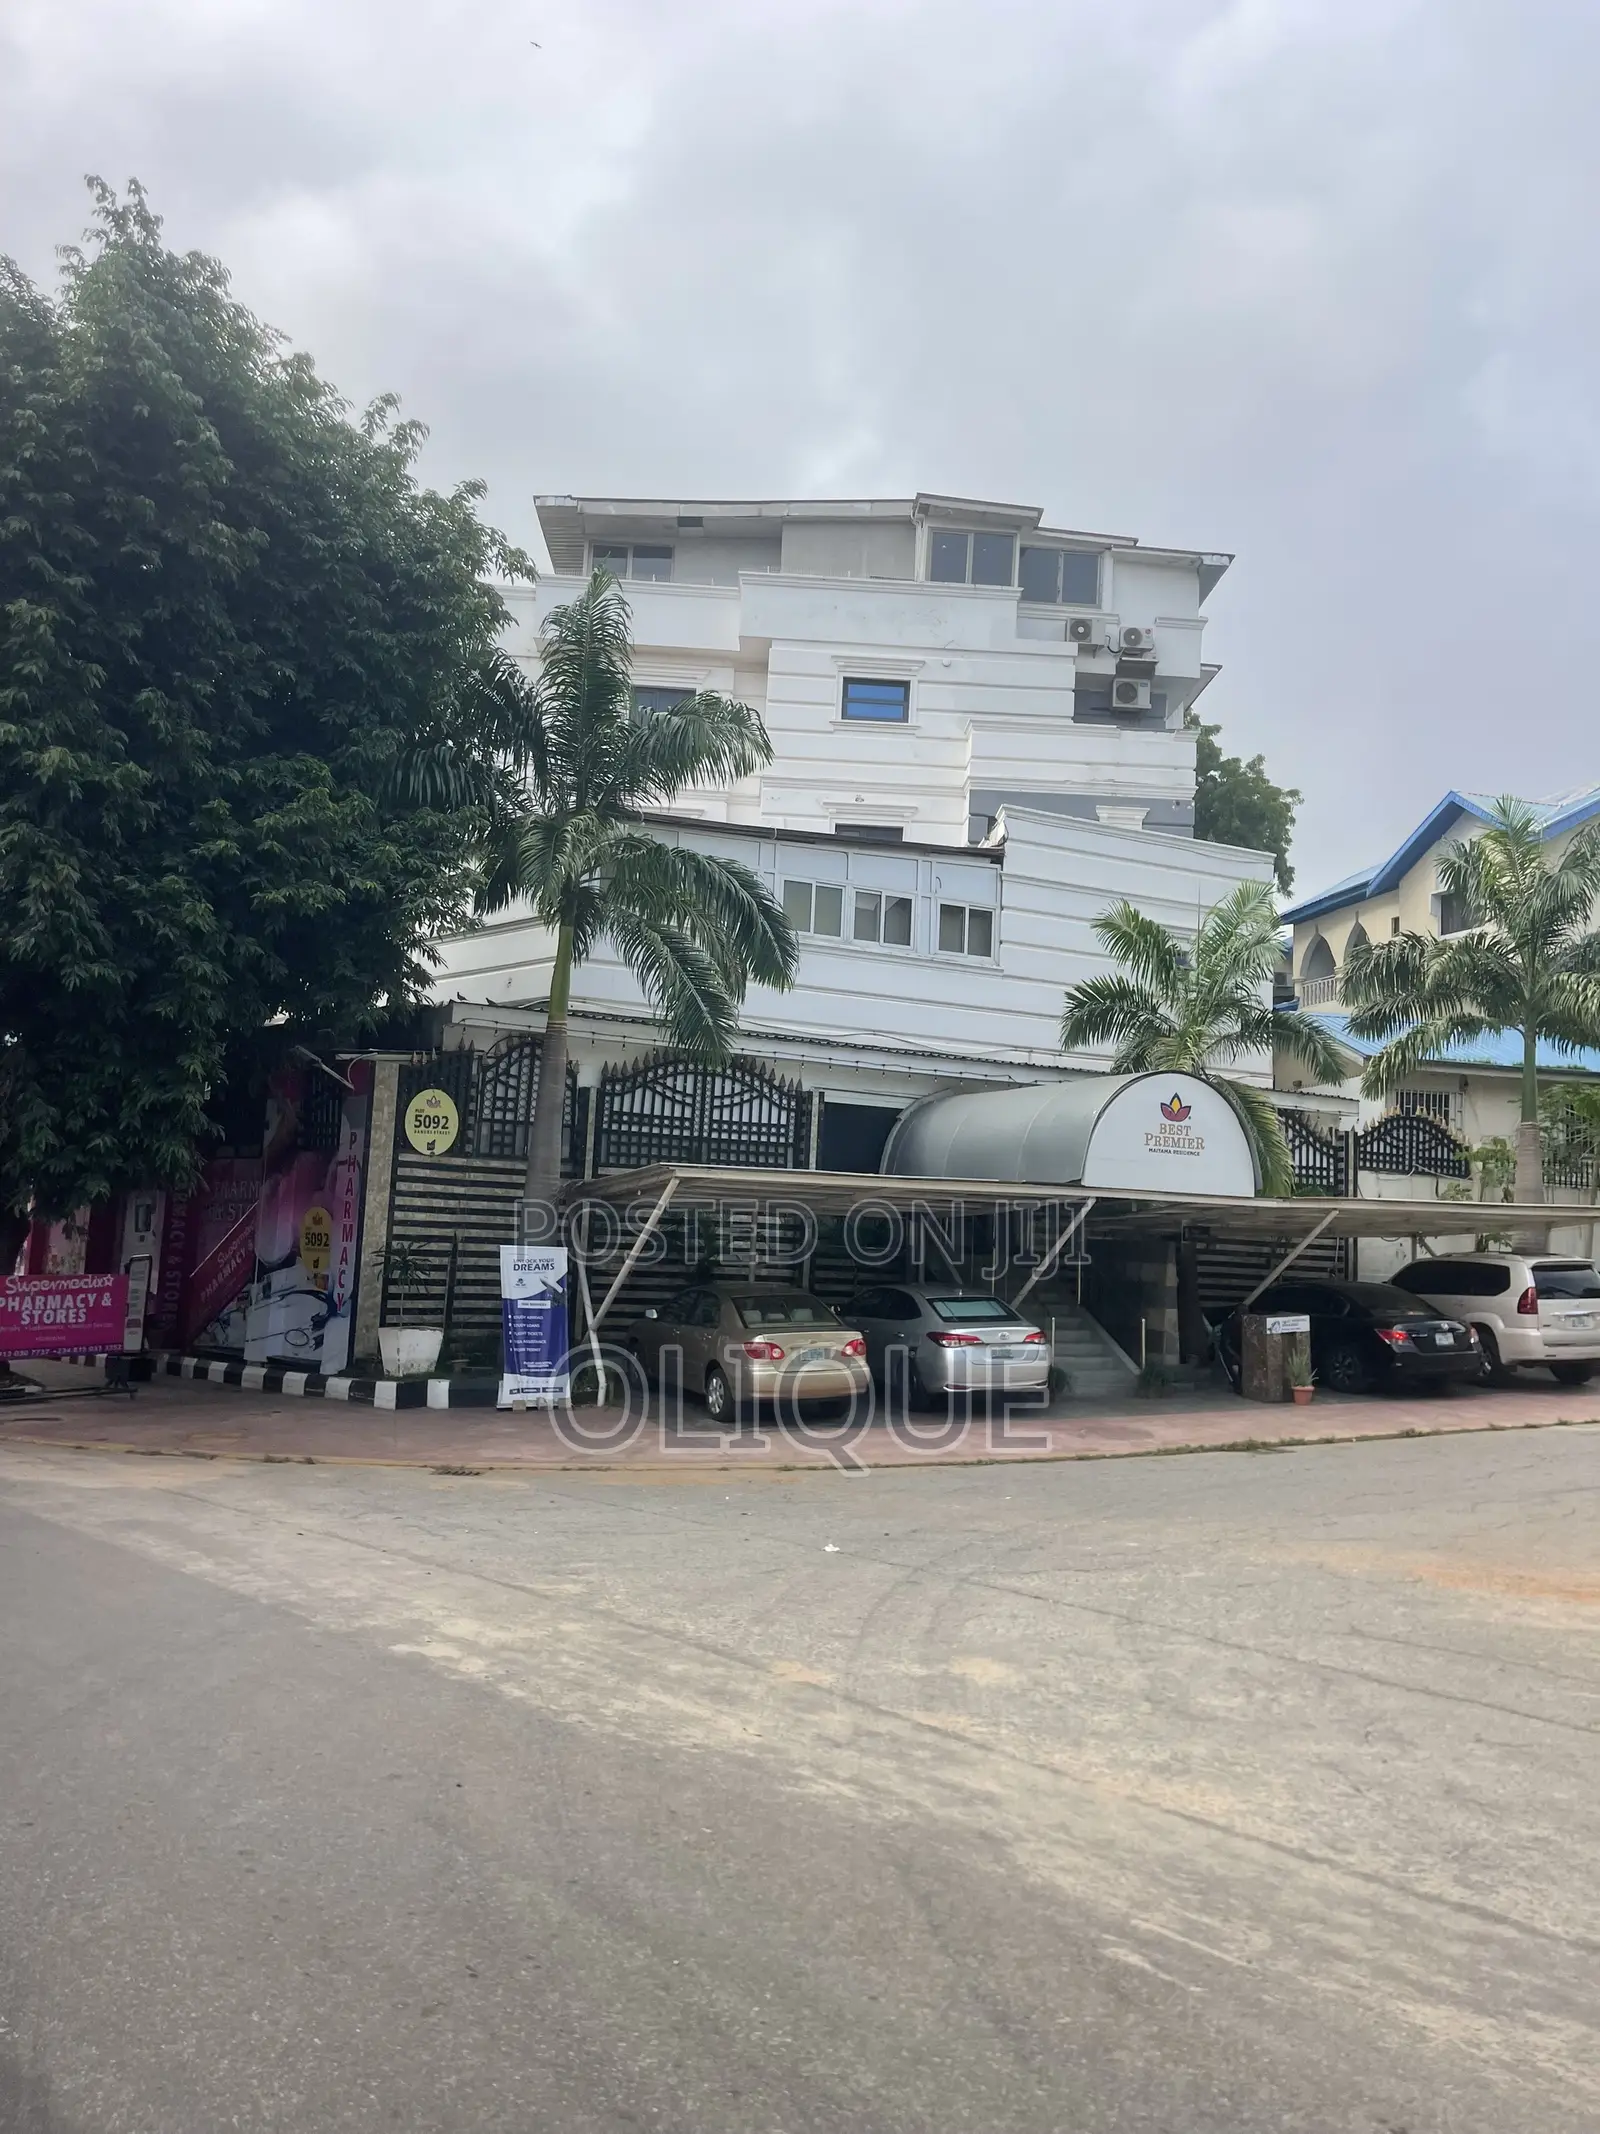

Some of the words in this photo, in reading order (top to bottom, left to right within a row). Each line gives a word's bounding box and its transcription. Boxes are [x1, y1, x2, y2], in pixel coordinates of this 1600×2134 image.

[414, 1114, 449, 1130] 5092
[1159, 1123, 1192, 1137] BEST
[1144, 1132, 1206, 1150] PREMIER
[337, 1131, 357, 1312] PHARMACY
[305, 1231, 330, 1247] 5092
[200, 1247, 247, 1302] PHARMACY
[513, 1263, 555, 1271] DREAMS
[0, 1293, 97, 1312] PHARMACY
[101, 1292, 112, 1307] &
[21, 1308, 87, 1325] STORES
